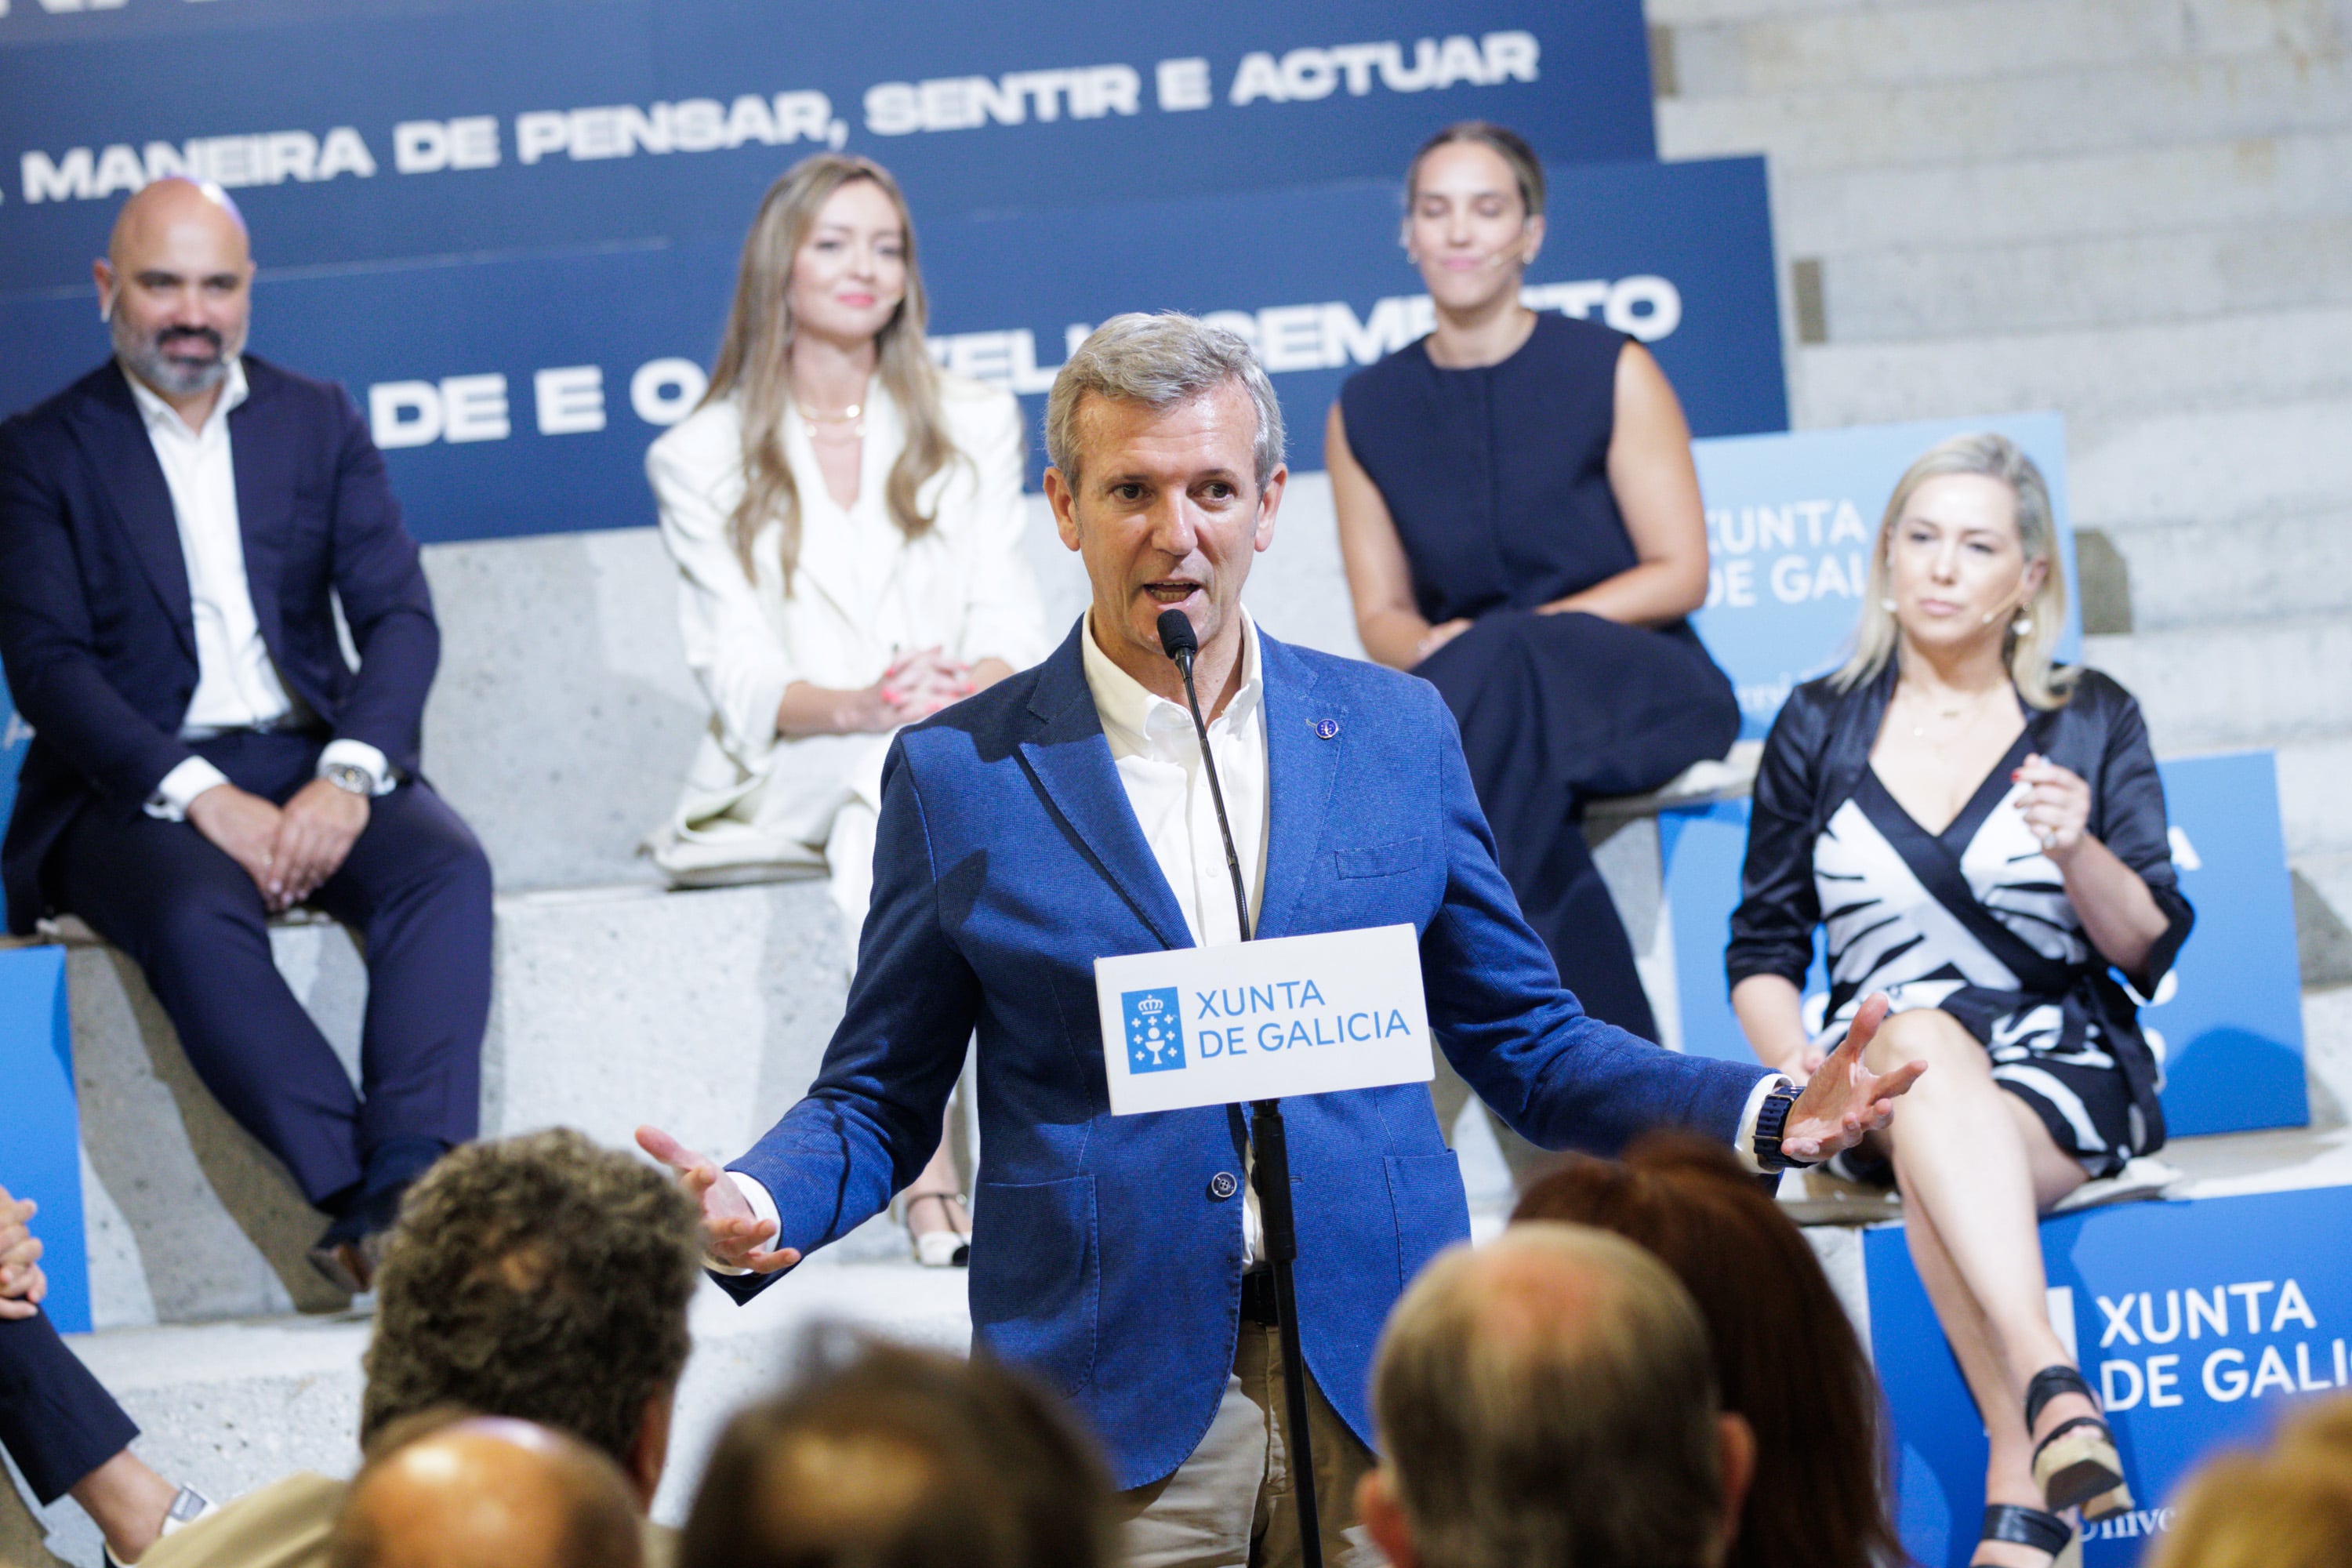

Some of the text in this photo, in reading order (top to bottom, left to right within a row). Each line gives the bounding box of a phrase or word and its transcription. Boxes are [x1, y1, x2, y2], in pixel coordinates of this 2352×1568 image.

[21, 30, 1541, 205] MANEIRA DE PENSAR, SENTIR E ACTUAR
[533, 364, 607, 436] E
[1196, 978, 1326, 1020] XUNTA
[1198, 1008, 1411, 1059] DE GALICIA
[2096, 1278, 2318, 1348] XUNTA
[2100, 1338, 2352, 1412] DE GALI
